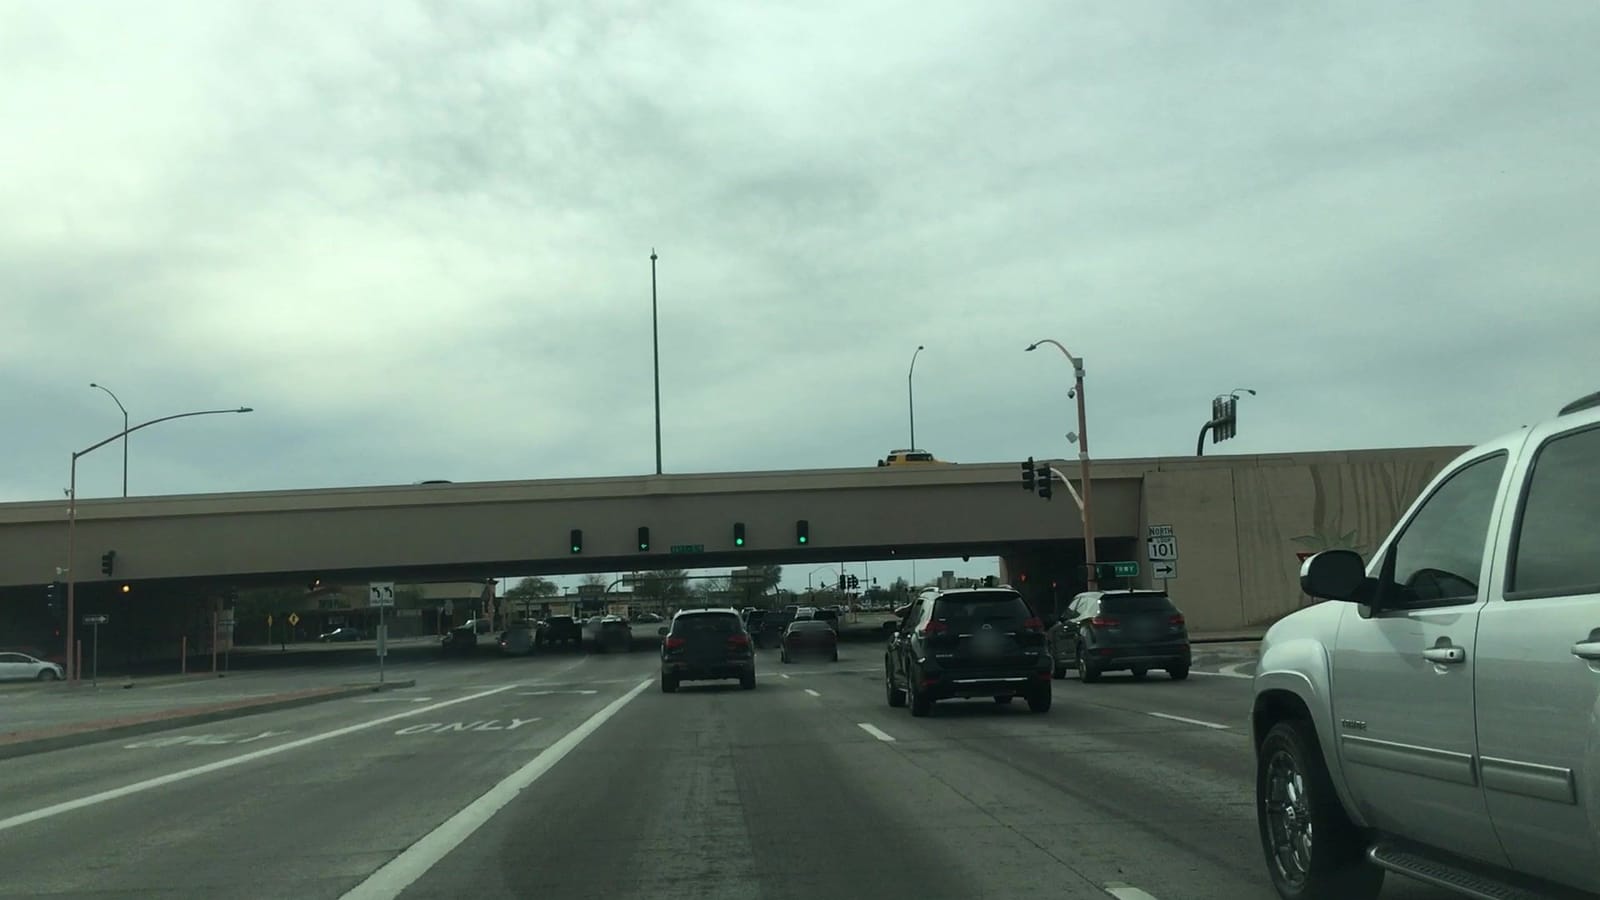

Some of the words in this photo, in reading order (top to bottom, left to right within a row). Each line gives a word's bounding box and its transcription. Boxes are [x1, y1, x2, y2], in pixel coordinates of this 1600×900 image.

[1149, 527, 1173, 536] NORTH
[1152, 543, 1174, 557] 101
[394, 717, 541, 735] ONLY
